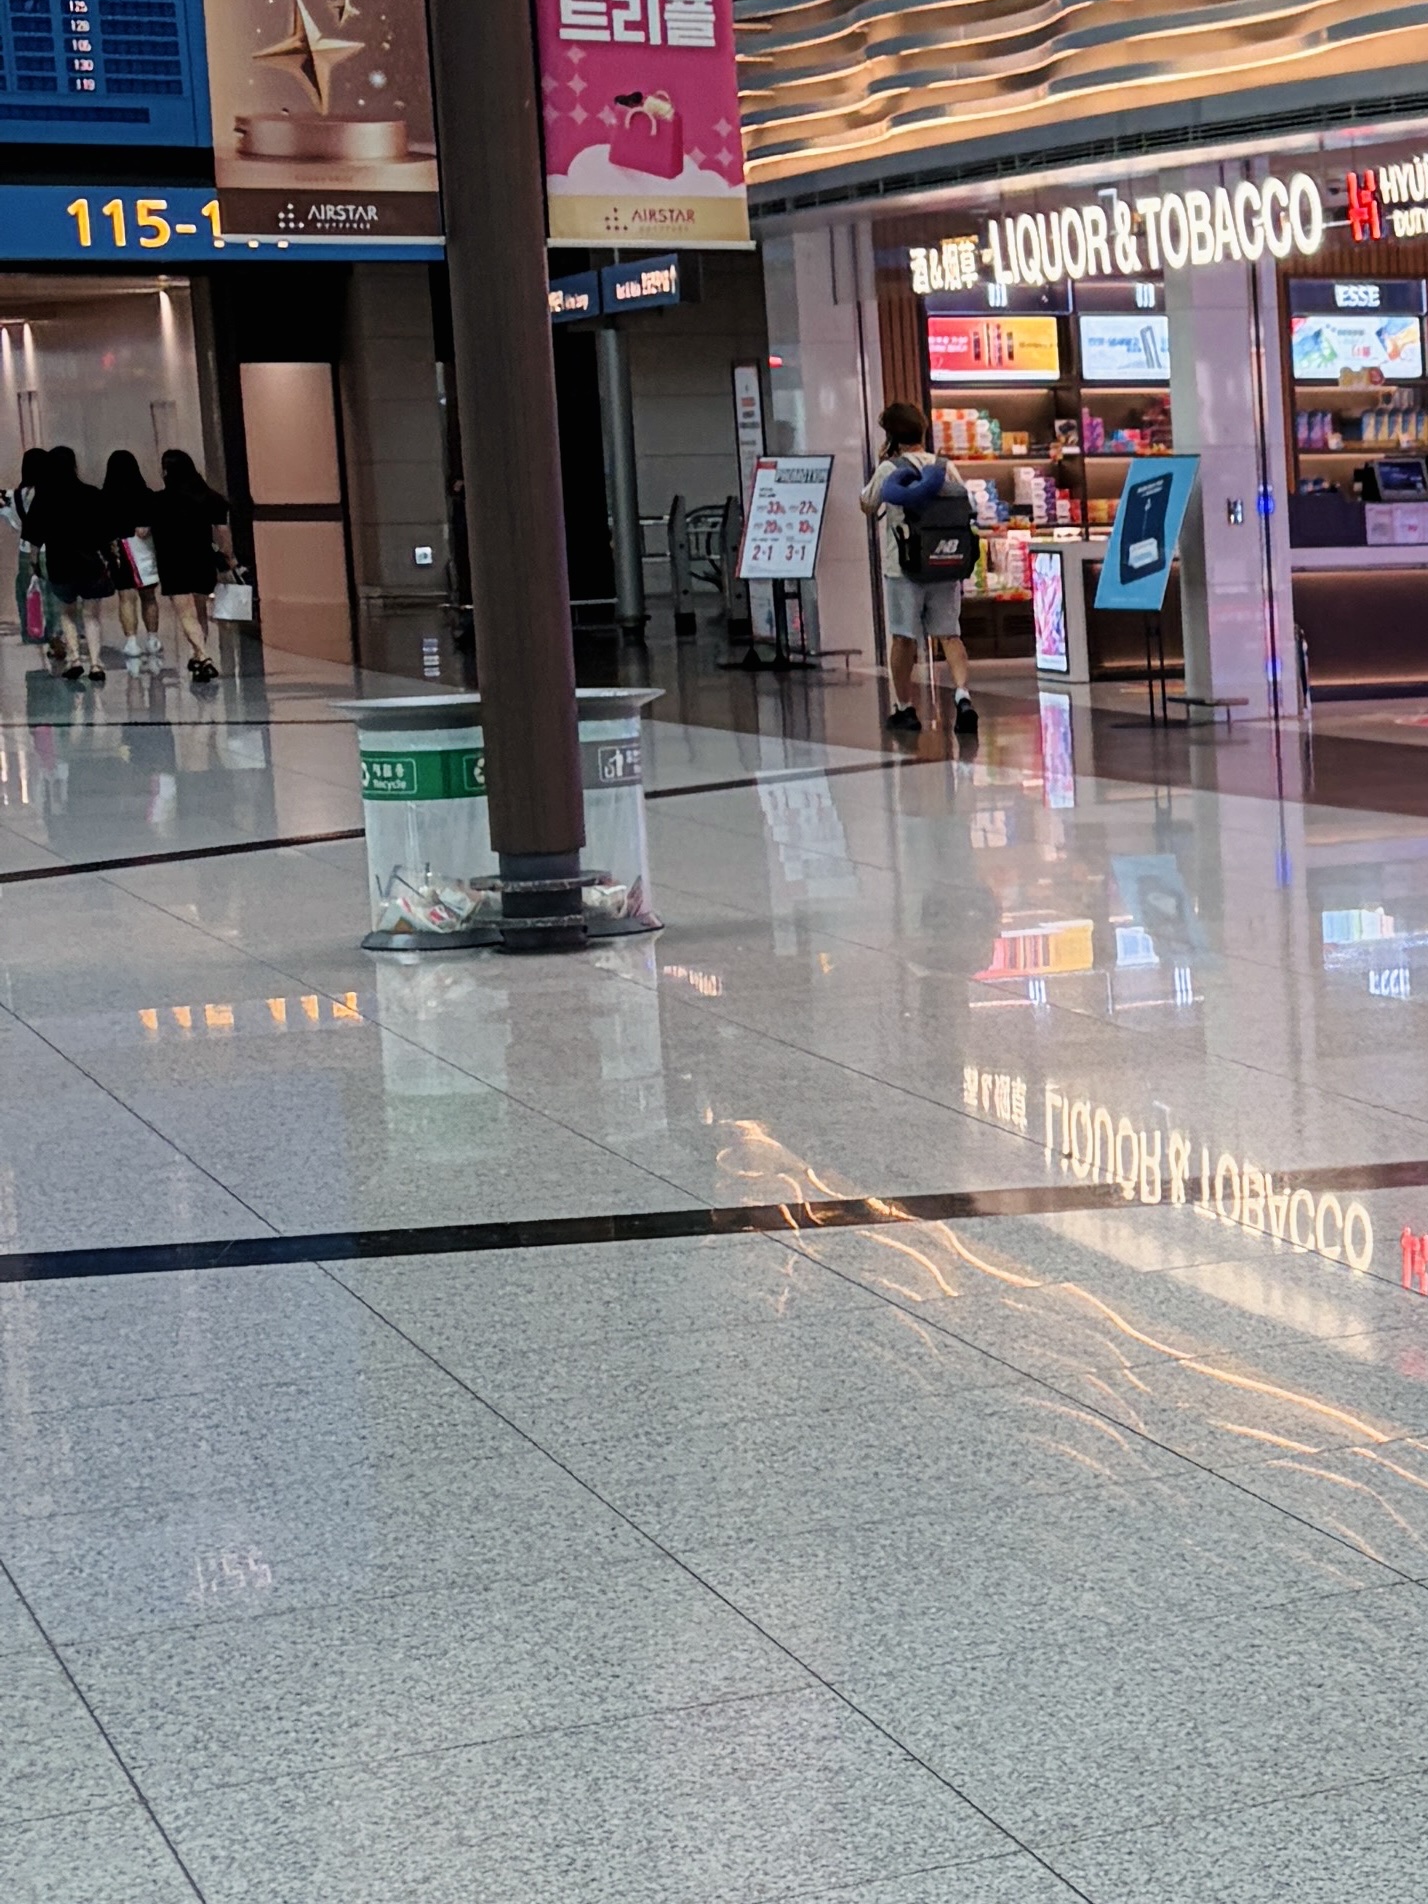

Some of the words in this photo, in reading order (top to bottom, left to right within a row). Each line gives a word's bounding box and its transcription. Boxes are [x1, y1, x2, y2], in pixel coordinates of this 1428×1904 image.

[308, 204, 379, 220] AIRSTAR
[631, 207, 697, 224] AIRSTAR
[988, 204, 1111, 286] LIQUOR
[1112, 198, 1142, 276] &
[1137, 171, 1323, 272] TOBACCO
[1334, 284, 1381, 307] ESSE
